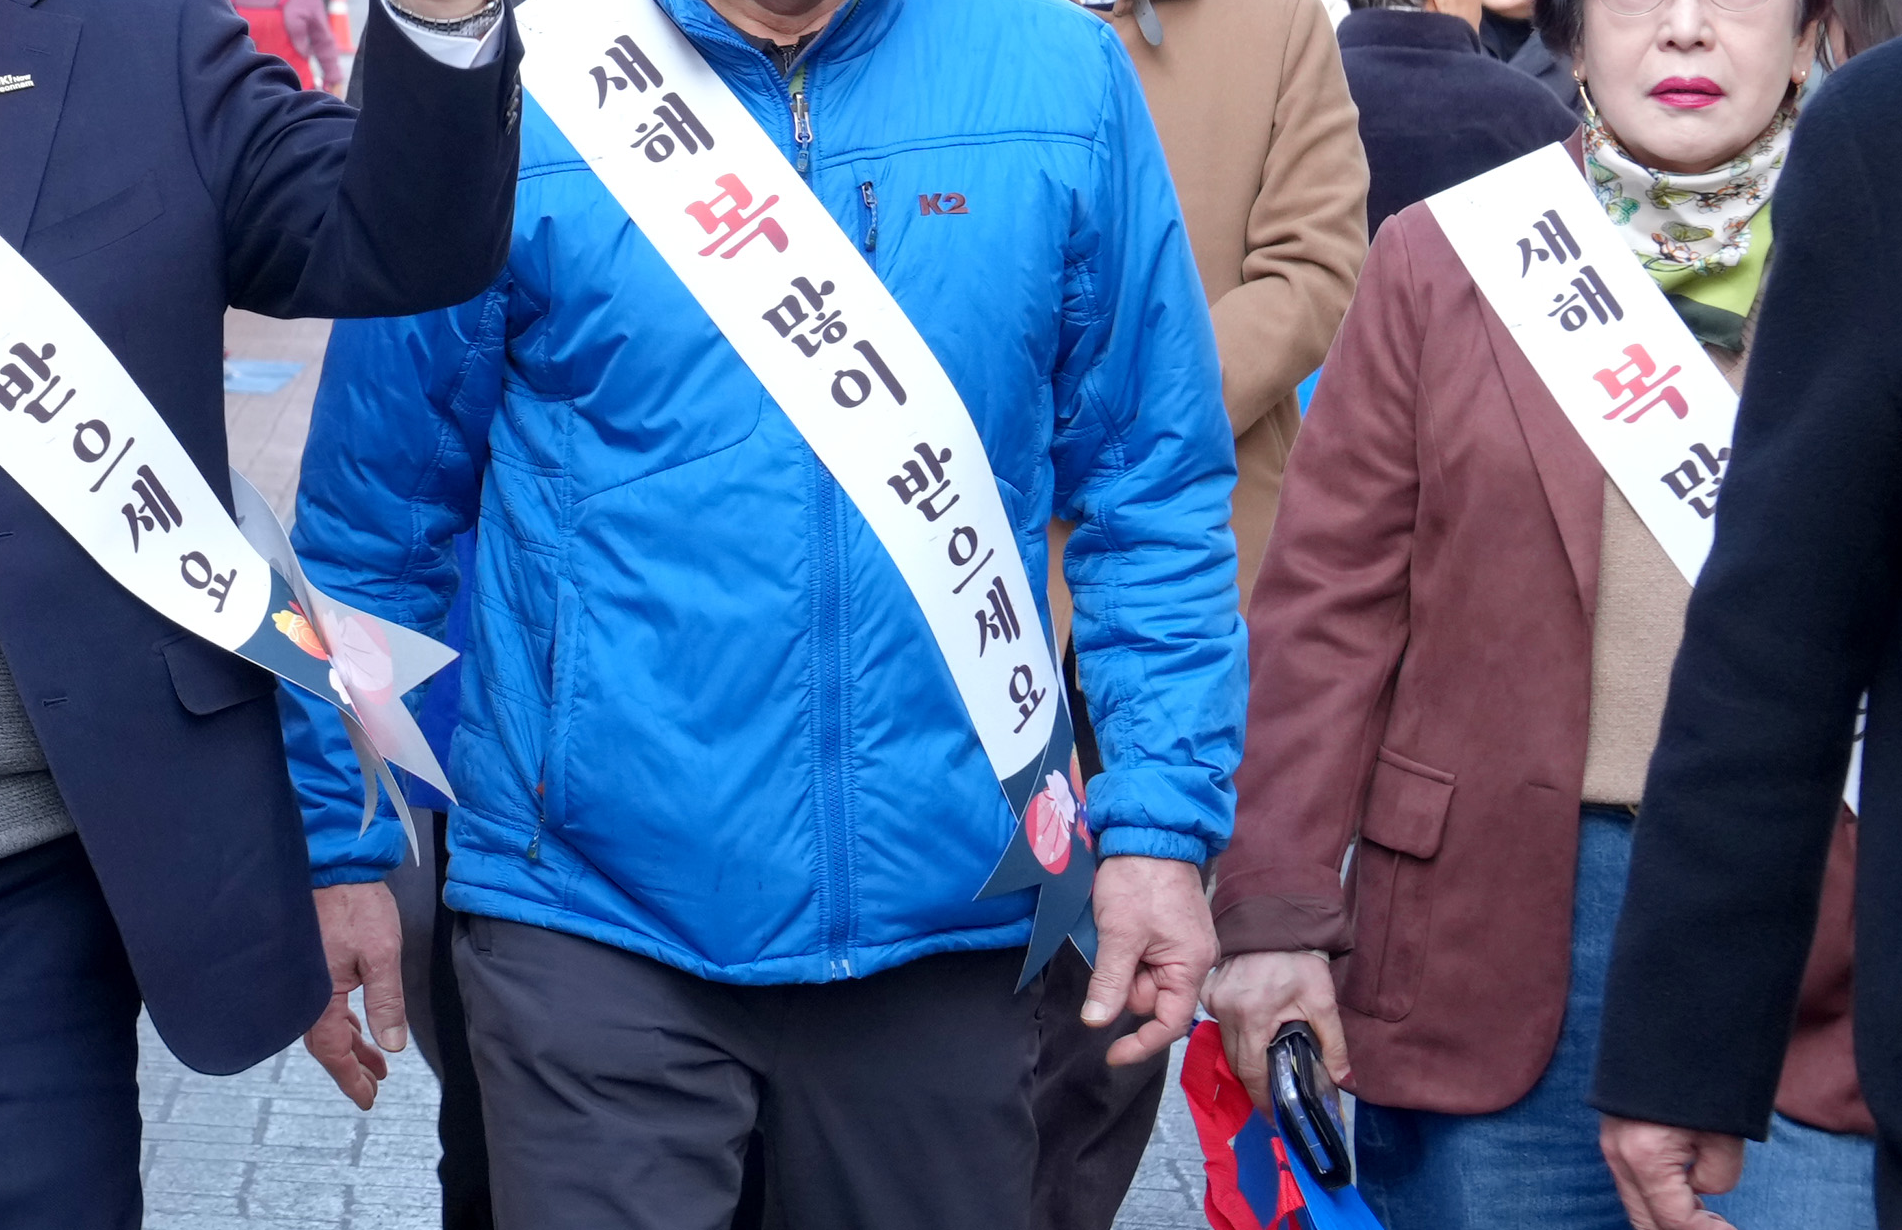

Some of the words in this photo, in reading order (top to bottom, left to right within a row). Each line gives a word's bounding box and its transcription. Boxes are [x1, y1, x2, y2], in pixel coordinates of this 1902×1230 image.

[918, 192, 971, 217] K2
[587, 33, 716, 164] 새해
[684, 172, 789, 262] 복
[761, 275, 908, 410] 많이
[887, 441, 1048, 735] 받으세요
[1515, 209, 1624, 332] 새해
[1592, 343, 1690, 424] 복
